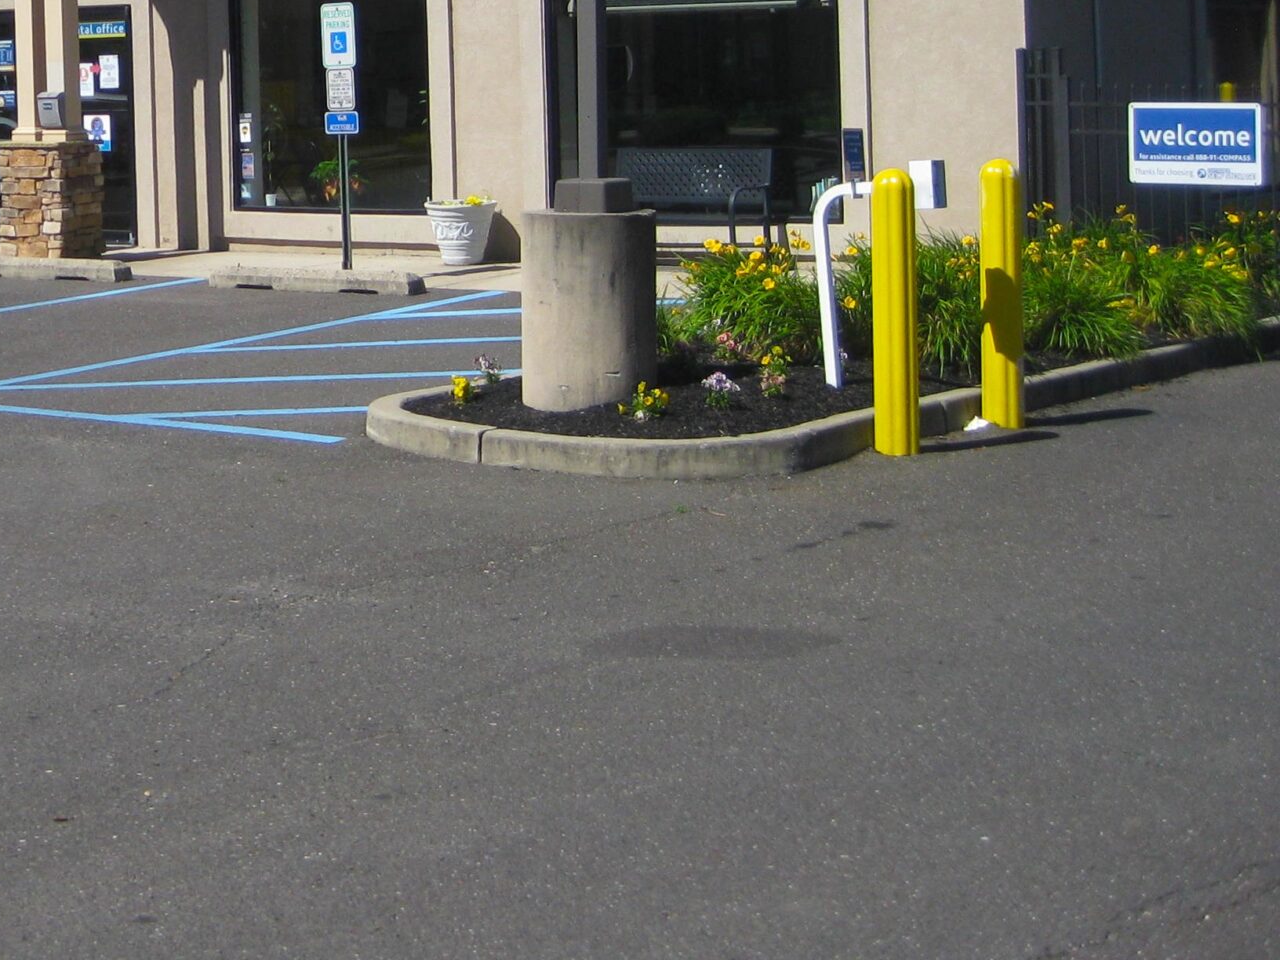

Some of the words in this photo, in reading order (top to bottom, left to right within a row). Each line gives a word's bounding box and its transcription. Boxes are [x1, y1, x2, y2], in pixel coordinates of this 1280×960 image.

[78, 24, 93, 35] tal
[96, 23, 124, 34] office
[326, 21, 350, 29] PARKING
[1139, 124, 1251, 147] welcome
